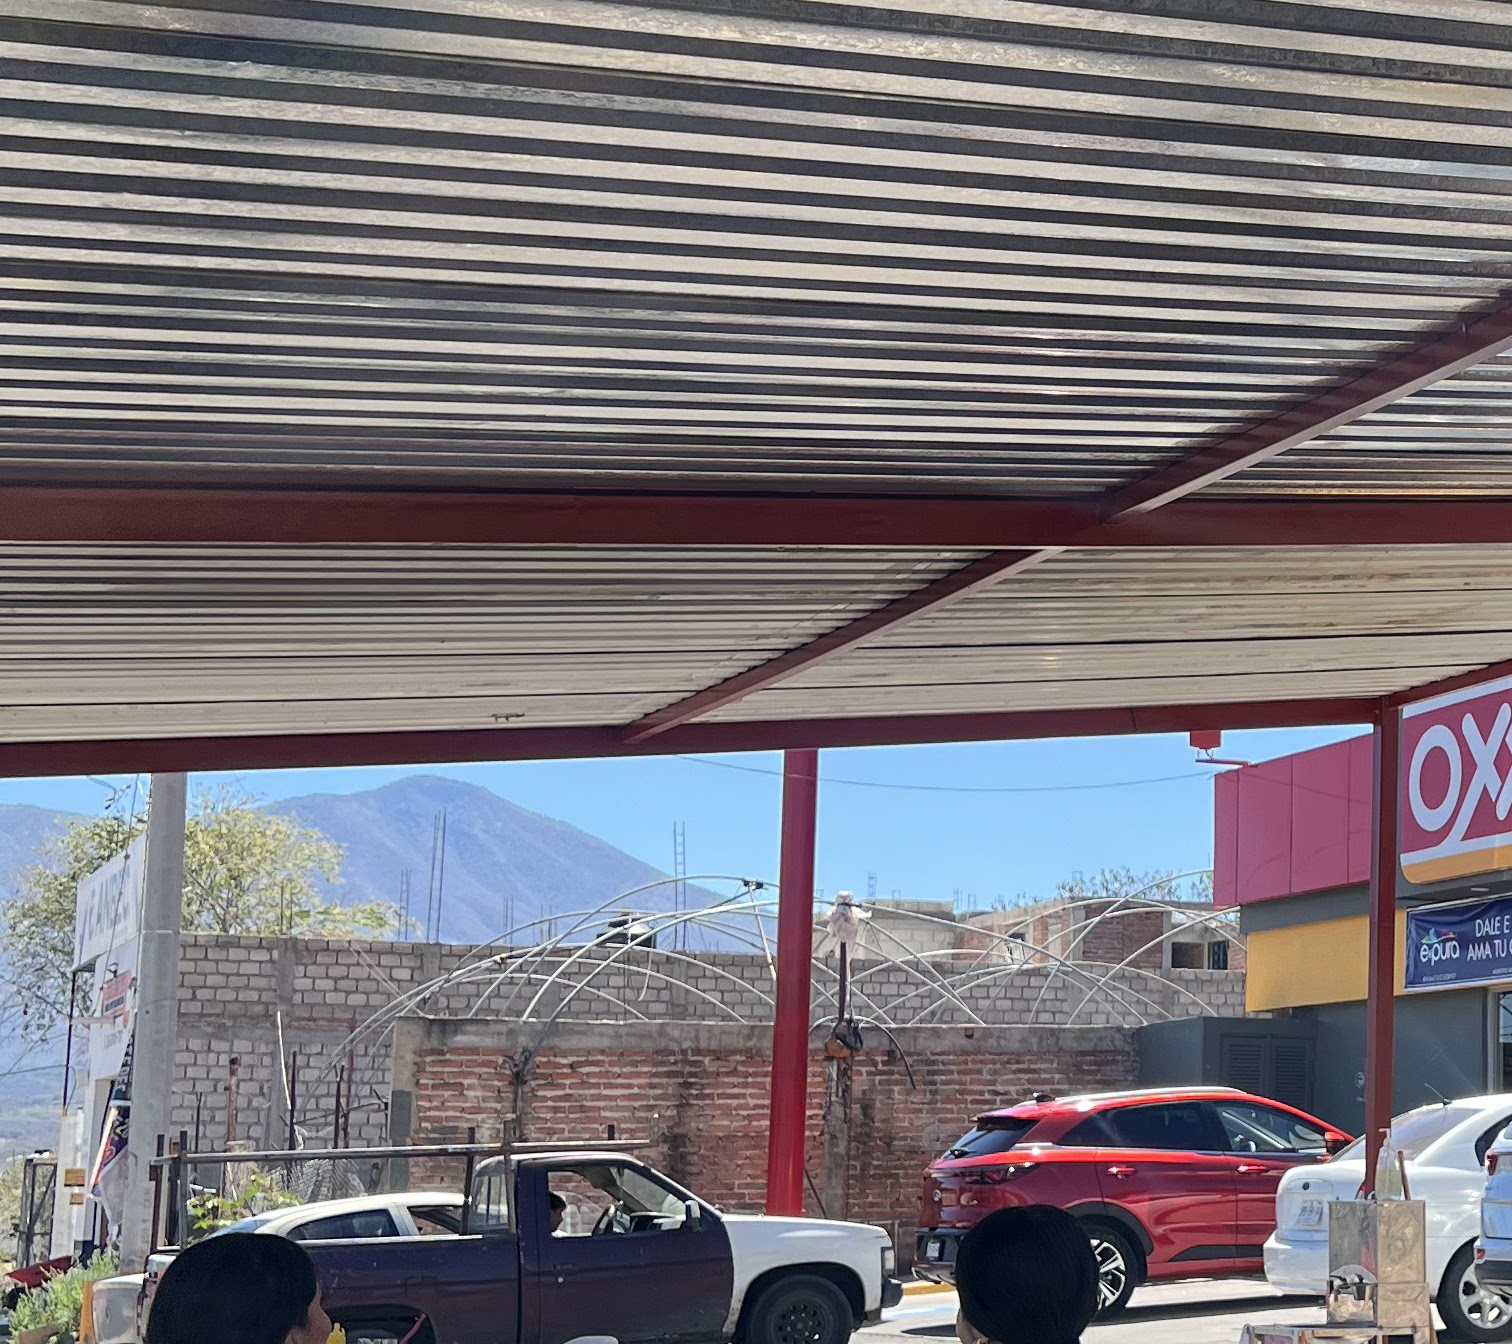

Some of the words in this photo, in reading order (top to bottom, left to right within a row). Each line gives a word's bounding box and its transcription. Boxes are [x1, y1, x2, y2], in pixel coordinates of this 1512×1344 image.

[1475, 915, 1501, 938] DALE
[1503, 914, 1511, 935] E
[1466, 939, 1493, 962] AMA
[1493, 938, 1507, 958] TU
